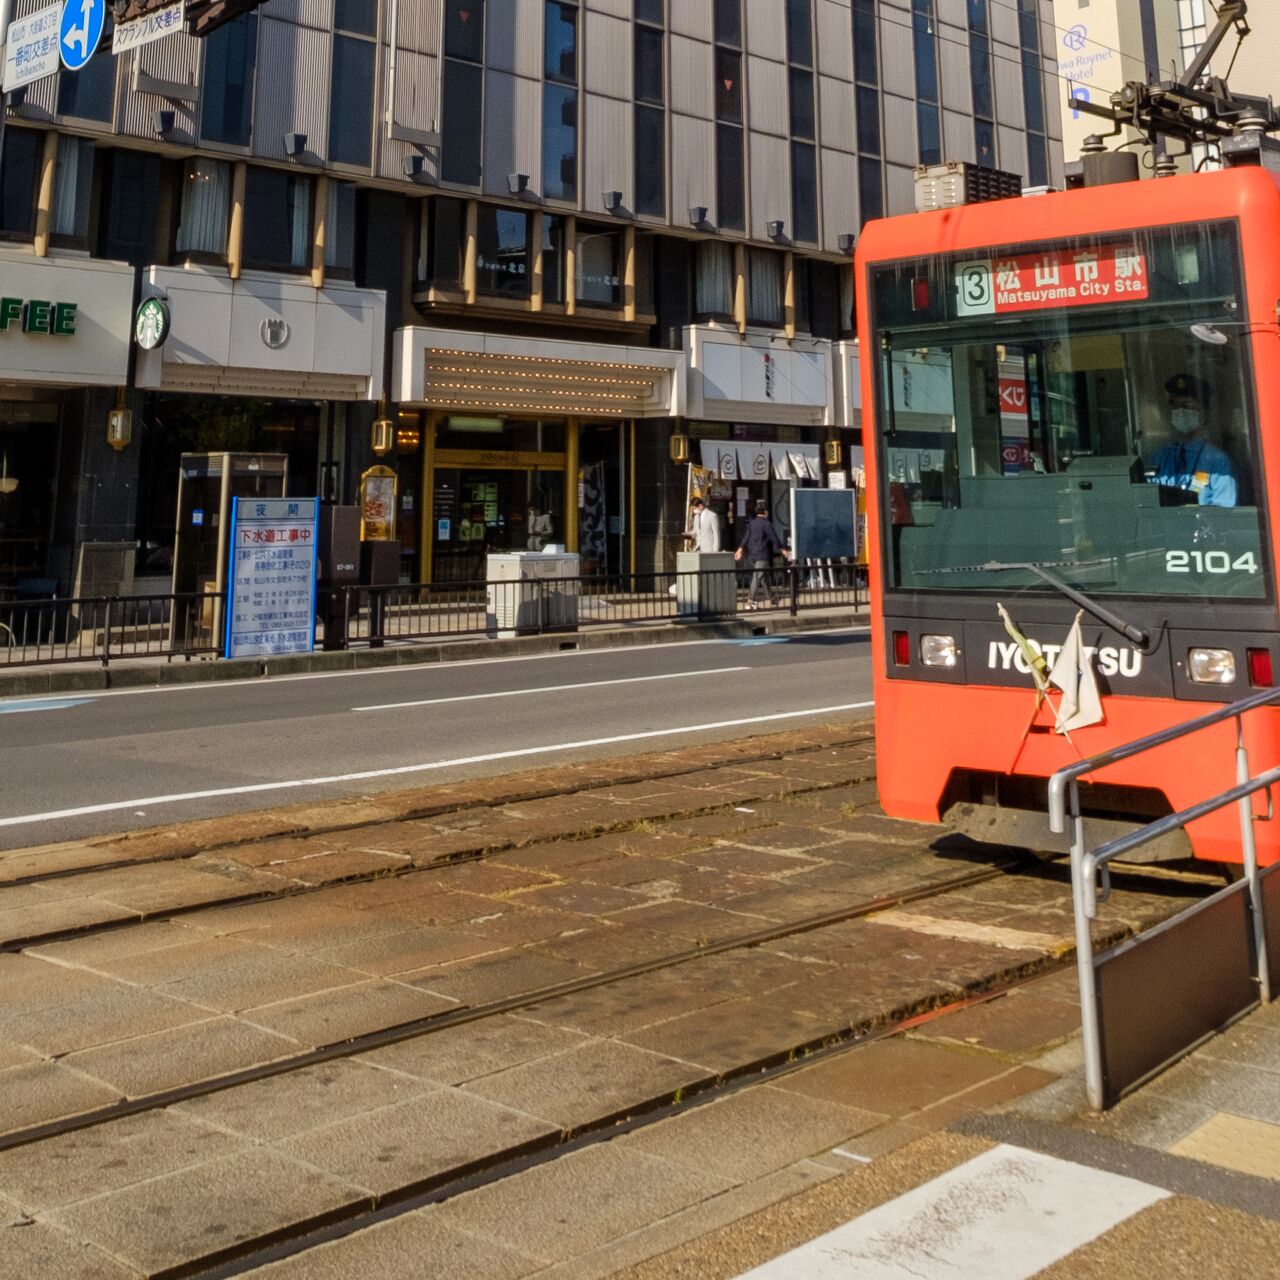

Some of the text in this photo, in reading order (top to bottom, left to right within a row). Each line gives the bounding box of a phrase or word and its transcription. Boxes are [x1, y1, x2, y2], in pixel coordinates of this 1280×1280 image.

[114, 3, 182, 48] スクランブル交差点
[7, 32, 59, 67] 一番町交差点
[1075, 48, 1113, 67] Roynet
[996, 248, 1143, 291] 松山市駅
[968, 270, 985, 301] 3
[997, 278, 1147, 305] Matsuyama City Sta.
[255, 503, 300, 517] 夜間
[240, 528, 312, 544] 下水道工事中
[1165, 550, 1259, 575] 2104
